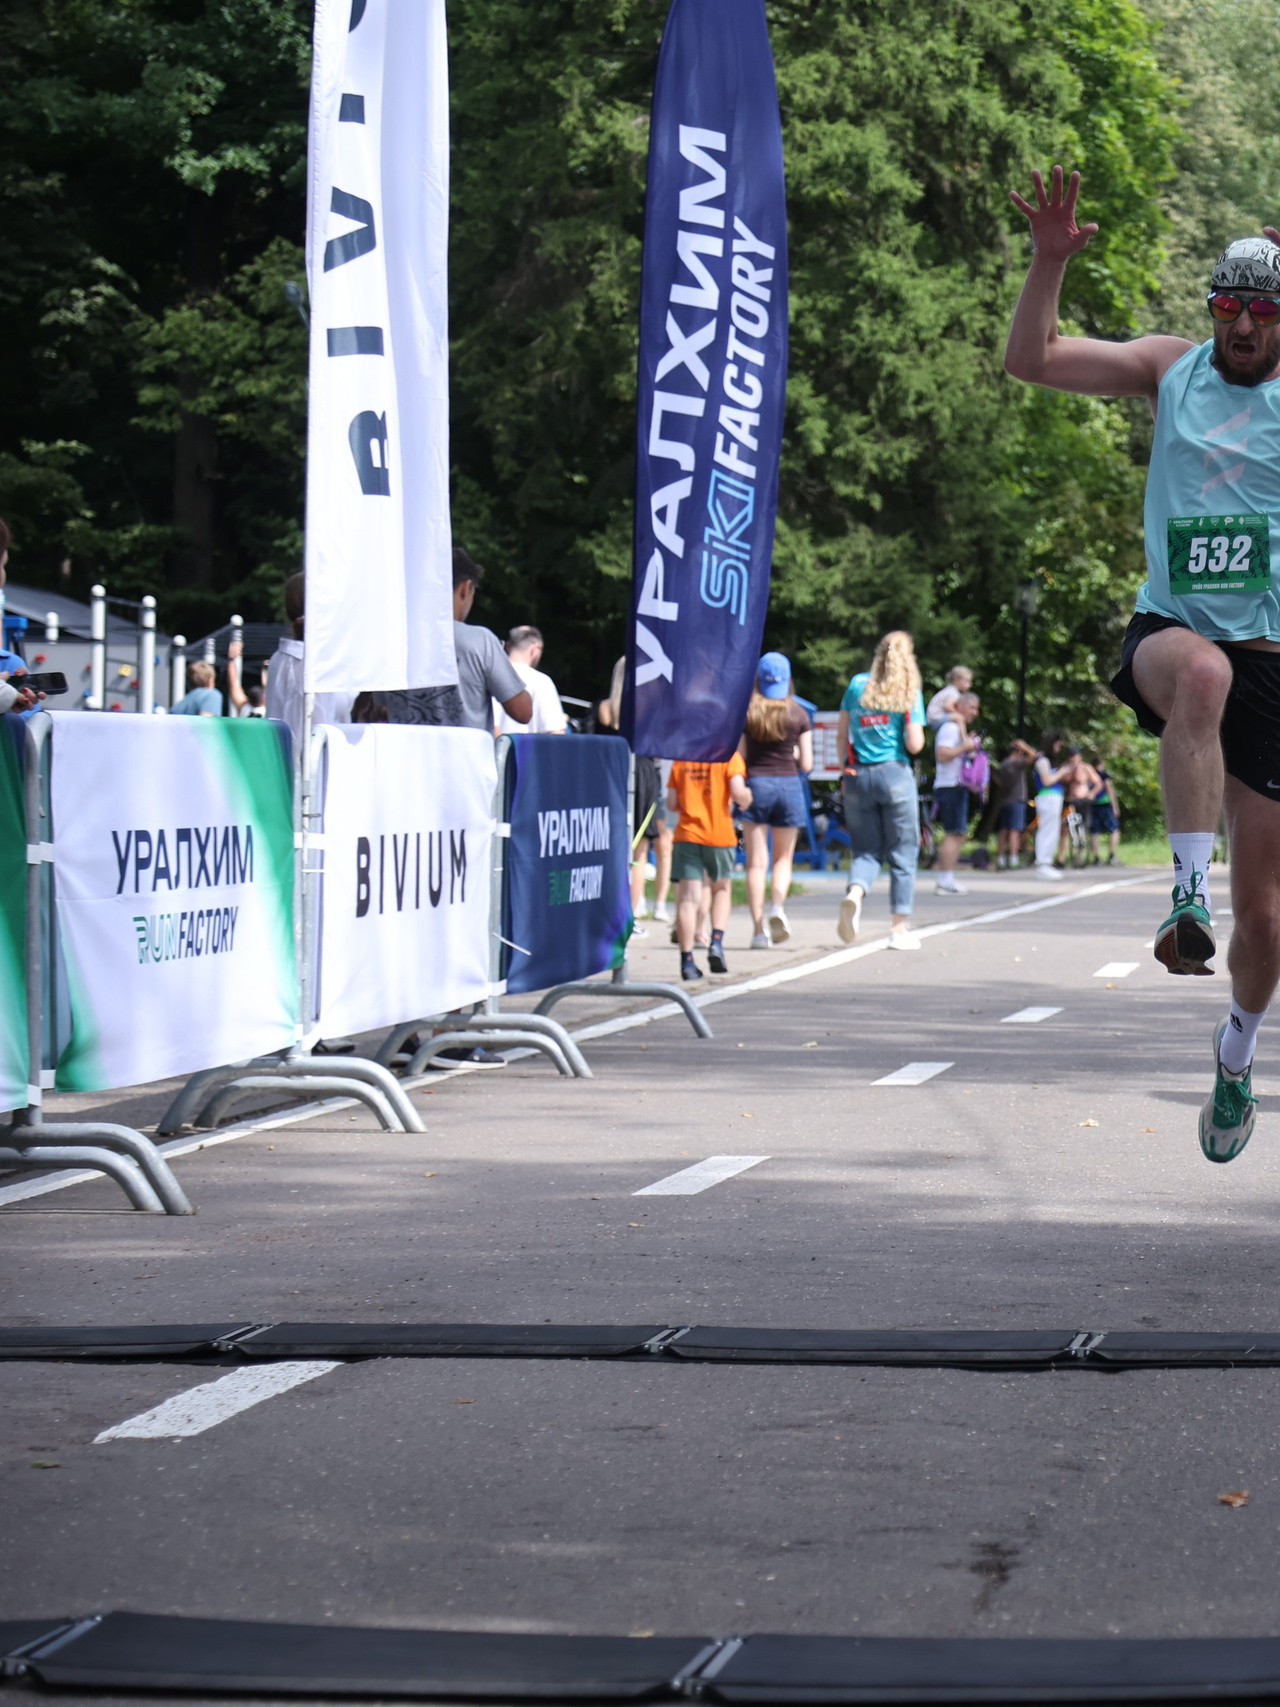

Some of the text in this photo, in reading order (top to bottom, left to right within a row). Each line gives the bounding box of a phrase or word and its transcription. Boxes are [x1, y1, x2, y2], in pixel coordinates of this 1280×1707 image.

[323, 0, 391, 497] BIVI
[636, 124, 727, 687] УРАЛХИМ
[1188, 535, 1252, 573] 532
[111, 824, 254, 895] УРАЛХИМ
[538, 806, 610, 858] УРАЛХИМ
[356, 828, 467, 918] BIVIUM
